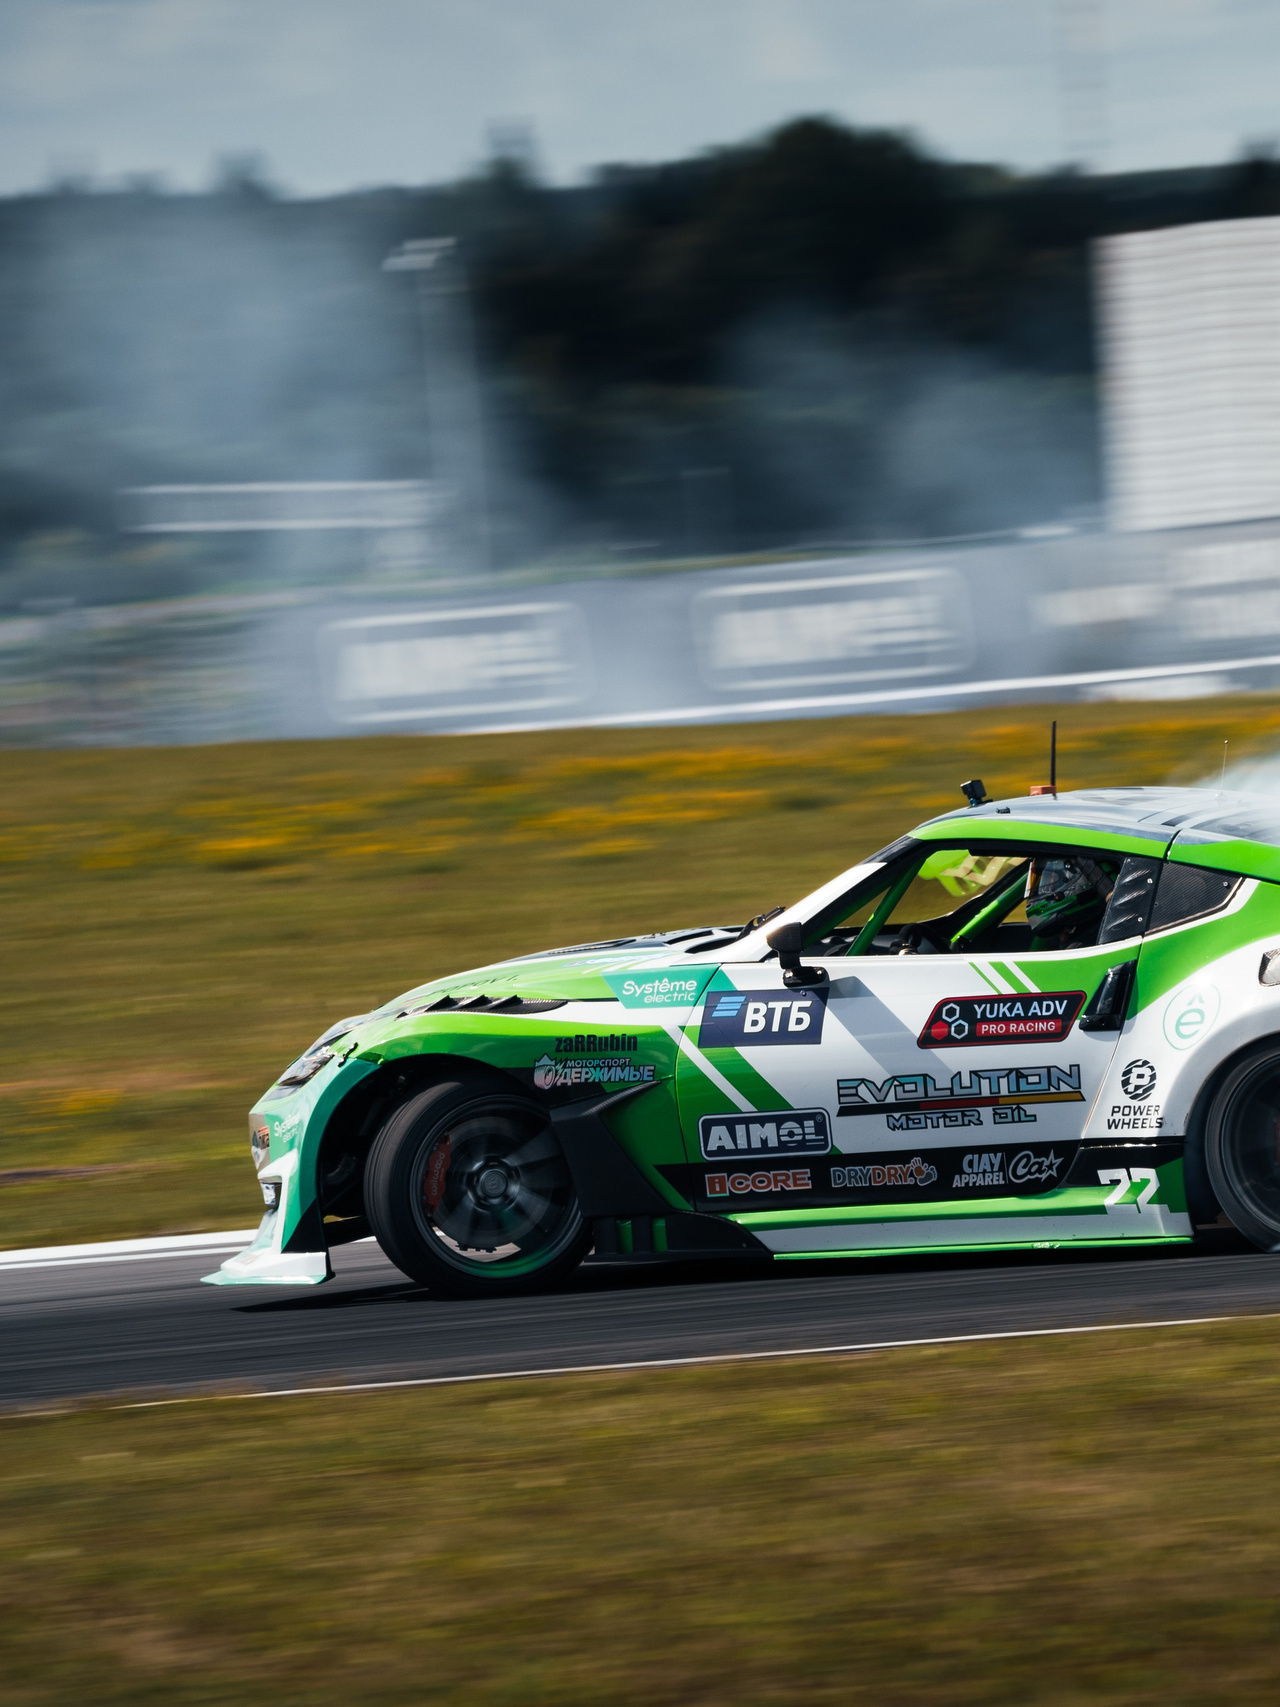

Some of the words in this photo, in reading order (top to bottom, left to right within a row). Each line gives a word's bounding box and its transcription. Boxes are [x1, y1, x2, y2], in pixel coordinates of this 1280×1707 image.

[622, 977, 698, 997] Systême
[644, 991, 696, 1004] electric
[743, 1000, 813, 1034] ВТБ
[974, 1002, 1024, 1019] YUKA
[1028, 1000, 1068, 1017] ADV
[981, 1023, 1006, 1034] PRO
[1009, 1021, 1056, 1033] RACING
[555, 1033, 638, 1053] zaRRubin
[566, 1058, 631, 1068] МОТОРСПОРТ
[837, 1064, 1082, 1104] EVOLUTION
[886, 1109, 983, 1131] MOTOR
[992, 1105, 1037, 1125] OIL
[1111, 1105, 1160, 1117] POWER
[1107, 1117, 1164, 1130] WHEELS
[952, 1171, 1005, 1188] APPAREL
